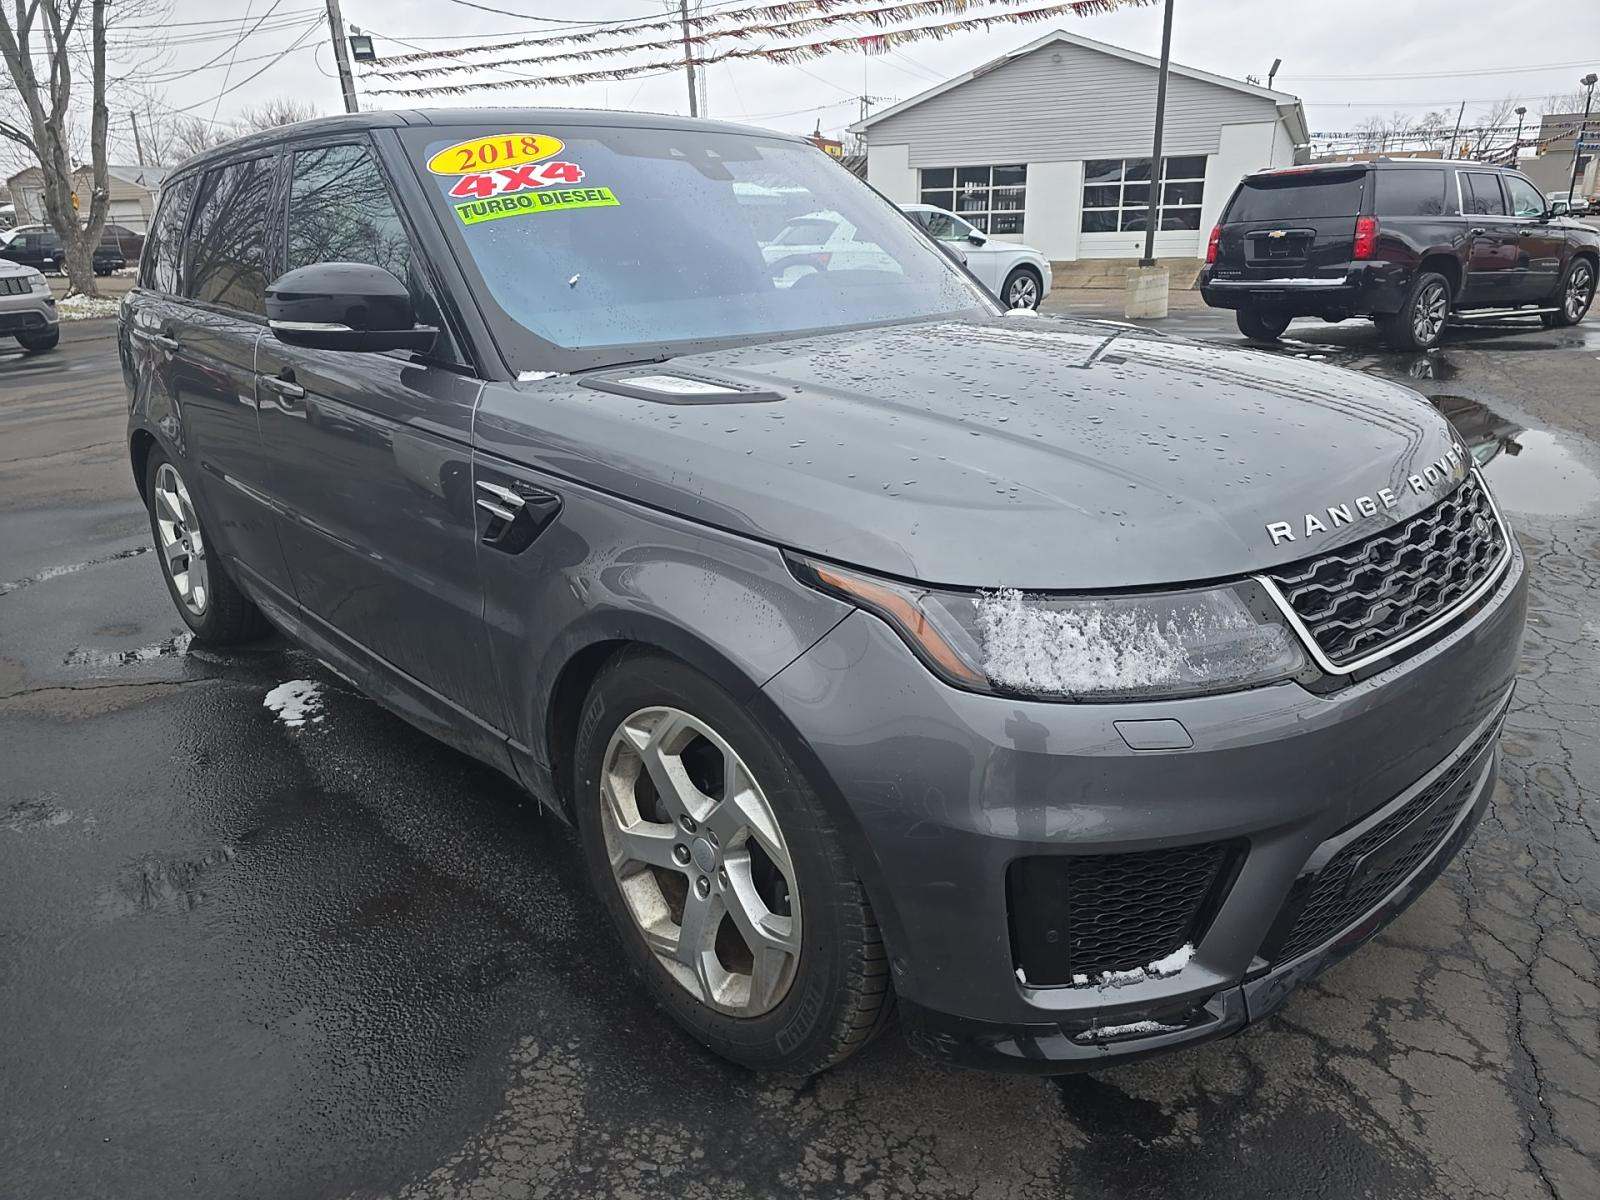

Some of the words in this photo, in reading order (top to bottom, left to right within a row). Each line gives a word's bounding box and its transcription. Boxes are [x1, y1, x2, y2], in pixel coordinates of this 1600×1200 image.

[456, 136, 540, 171] 2018
[458, 195, 533, 219] TURBO
[540, 189, 611, 206] DIESEL
[1266, 488, 1398, 545] RANGE
[1408, 442, 1466, 494] ROVER
